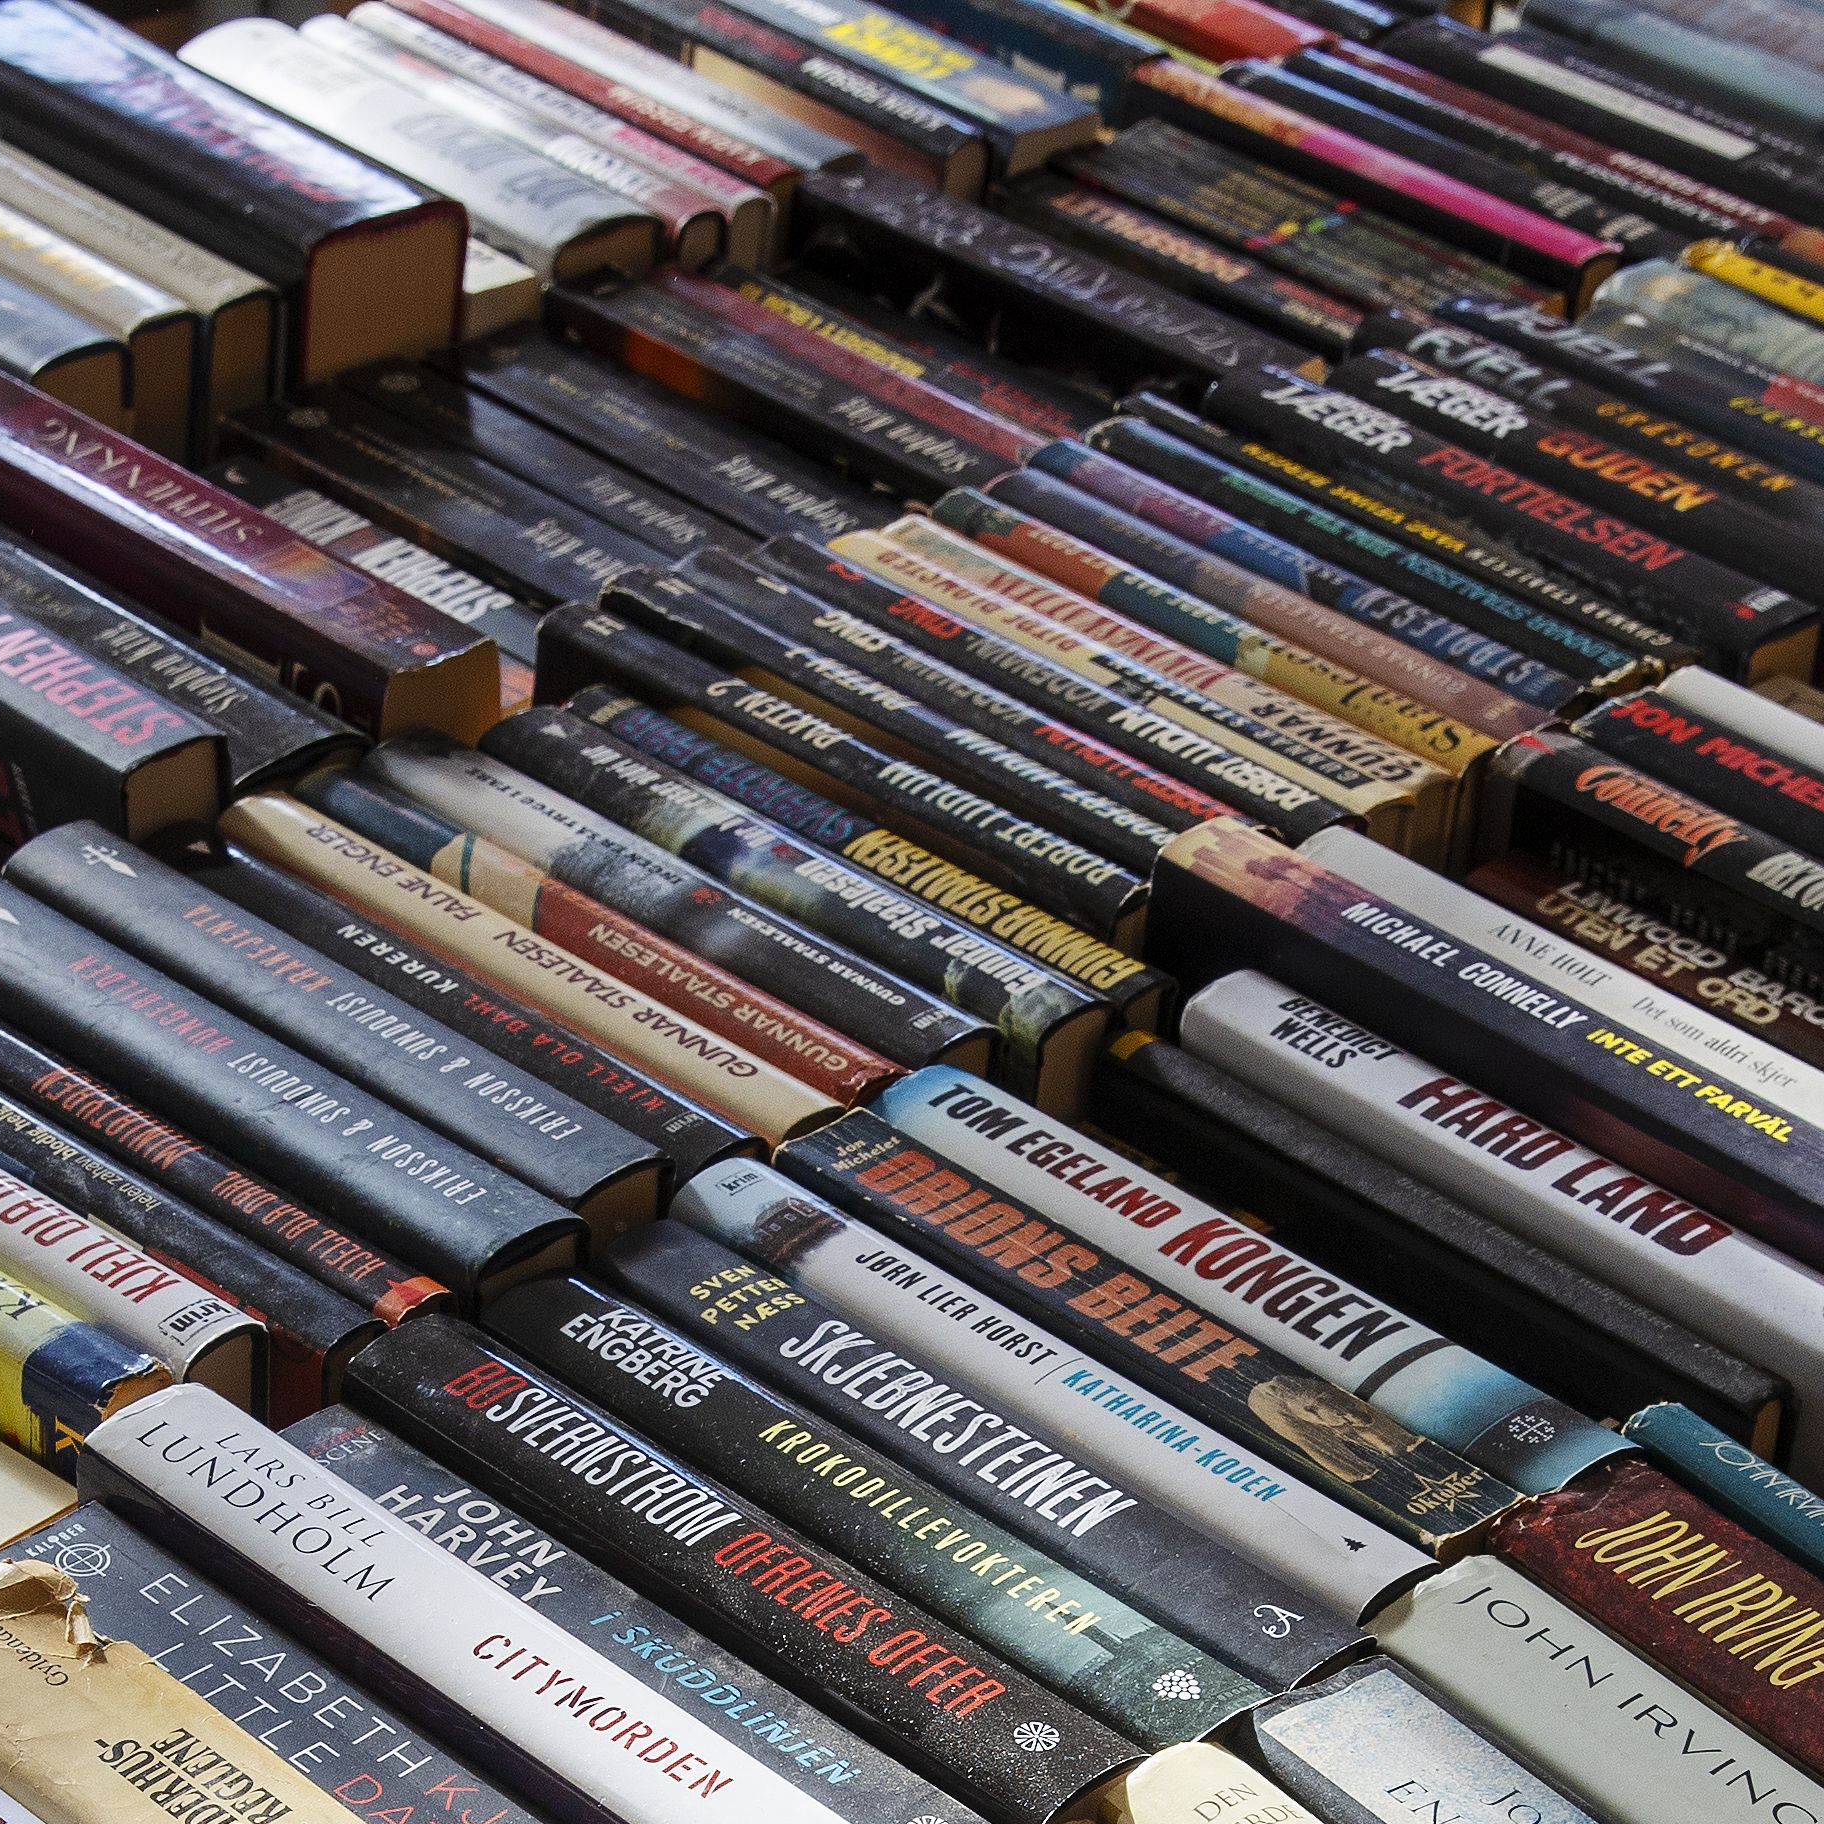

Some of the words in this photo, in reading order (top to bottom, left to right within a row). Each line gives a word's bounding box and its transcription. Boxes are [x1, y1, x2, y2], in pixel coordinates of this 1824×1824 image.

[1338, 898, 1459, 970] MICHAEL
[1456, 956, 1592, 1033] CONNELLY
[1584, 1023, 1652, 1066] INTE
[1643, 1052, 1703, 1089] ETT
[1690, 1075, 1796, 1146] FARVÄL
[924, 1080, 1029, 1143] TOM
[1024, 1128, 1187, 1233] EGELAND
[1156, 1211, 1417, 1367] KONGEN
[1396, 1074, 1574, 1181] HARD
[1549, 1147, 1735, 1259] LAND
[592, 1305, 730, 1391] KATRINE
[852, 1148, 1103, 1295] ORIONS
[1071, 1269, 1265, 1389] BELTE
[558, 1312, 706, 1411] ENGBERG
[775, 1316, 1142, 1543] SKJEBNESTEINEN
[1059, 1366, 1290, 1508] KATHARINA-KODEN
[134, 1420, 399, 1605] LUNDHOLM
[754, 1415, 1105, 1642] KROKODILLEVOKTEREN
[1701, 1436, 1793, 1489] JOHN
[711, 1531, 891, 1646] OFRENES
[867, 1627, 1008, 1725] OFFER
[1453, 1585, 1614, 1691] JOHN
[1575, 1507, 1718, 1598] JOHN
[138, 1570, 438, 1780] ELIZABETH
[470, 1630, 737, 1803] CITYMORDEN
[609, 1623, 864, 1788] SKUDDLINJEN
[147, 1727, 298, 1821] REGLENE
